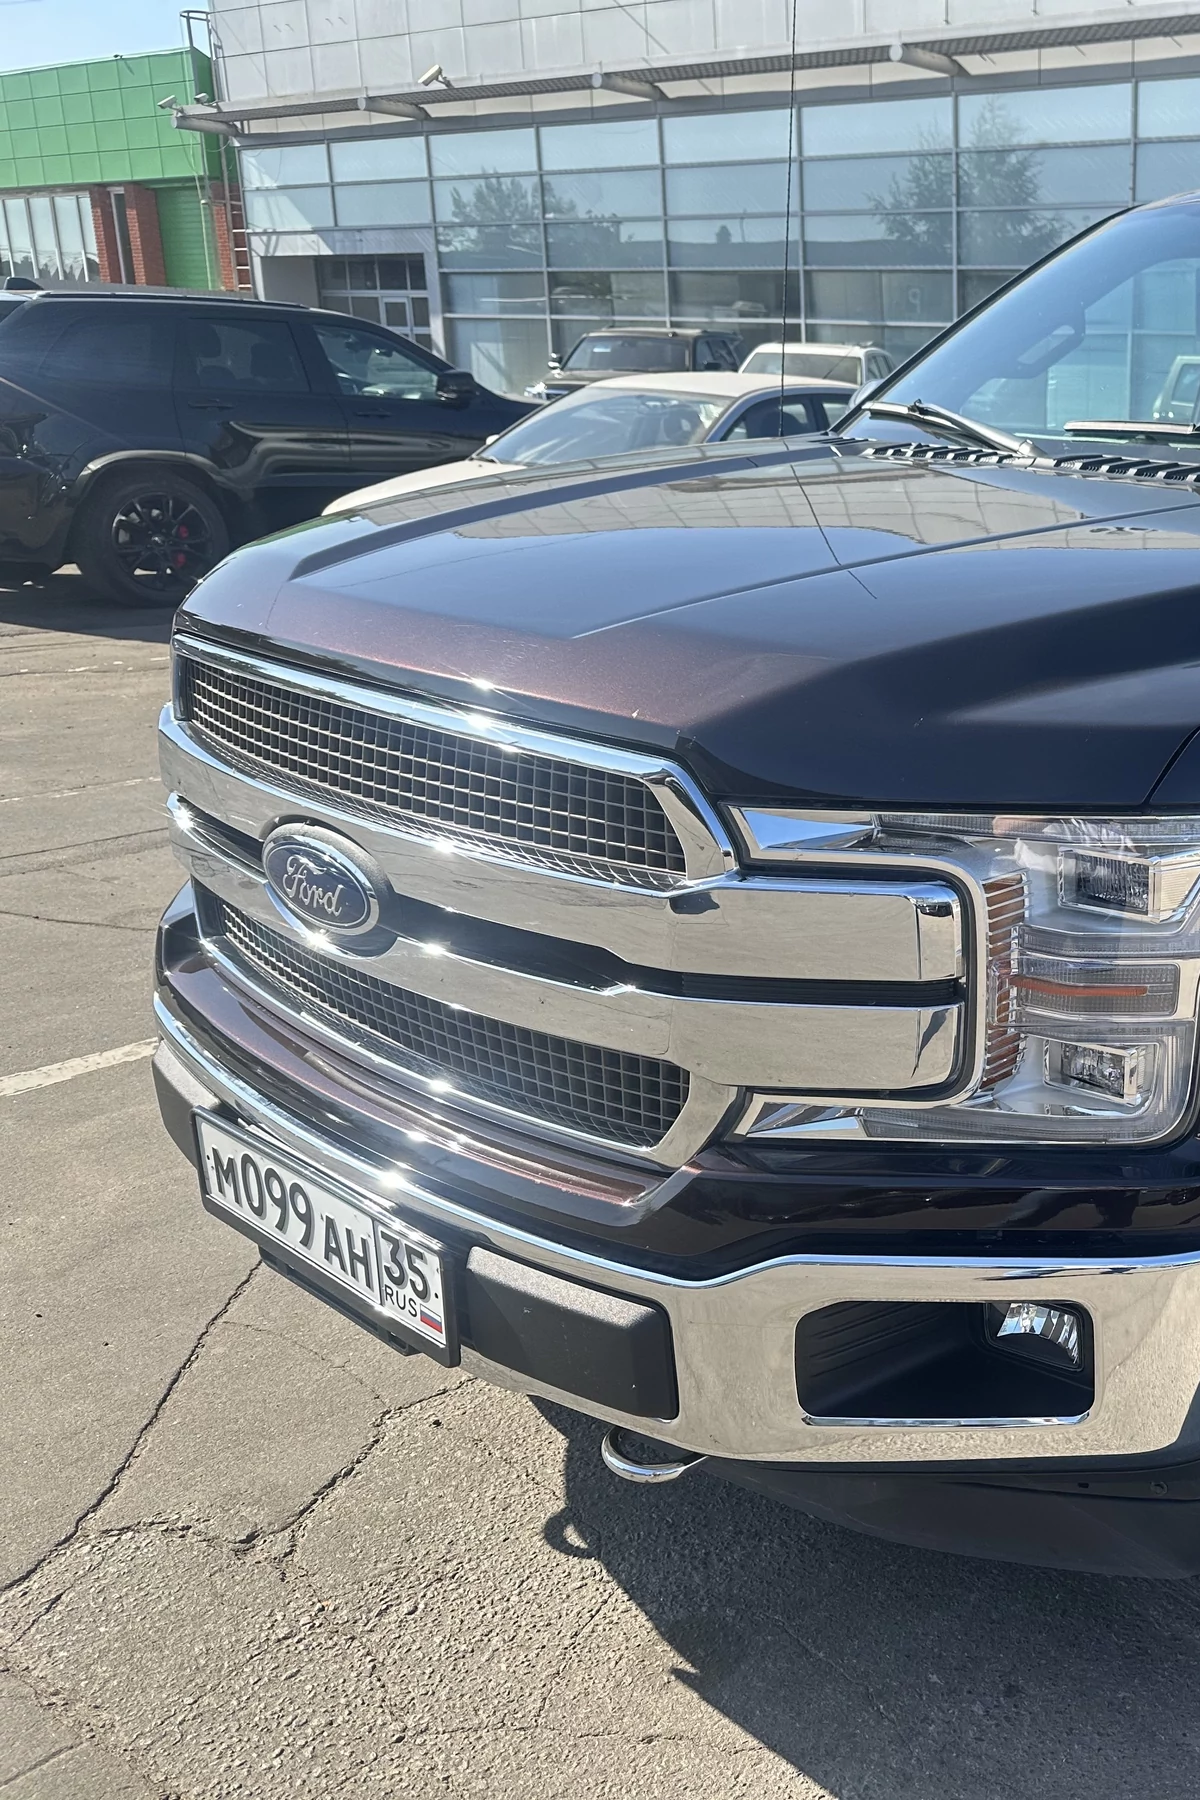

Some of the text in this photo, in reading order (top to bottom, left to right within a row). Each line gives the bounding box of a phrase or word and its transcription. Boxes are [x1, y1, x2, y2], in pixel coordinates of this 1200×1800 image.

[283, 854, 343, 917] Ford
[381, 1230, 430, 1301] 35
[385, 1286, 417, 1318] RUS
